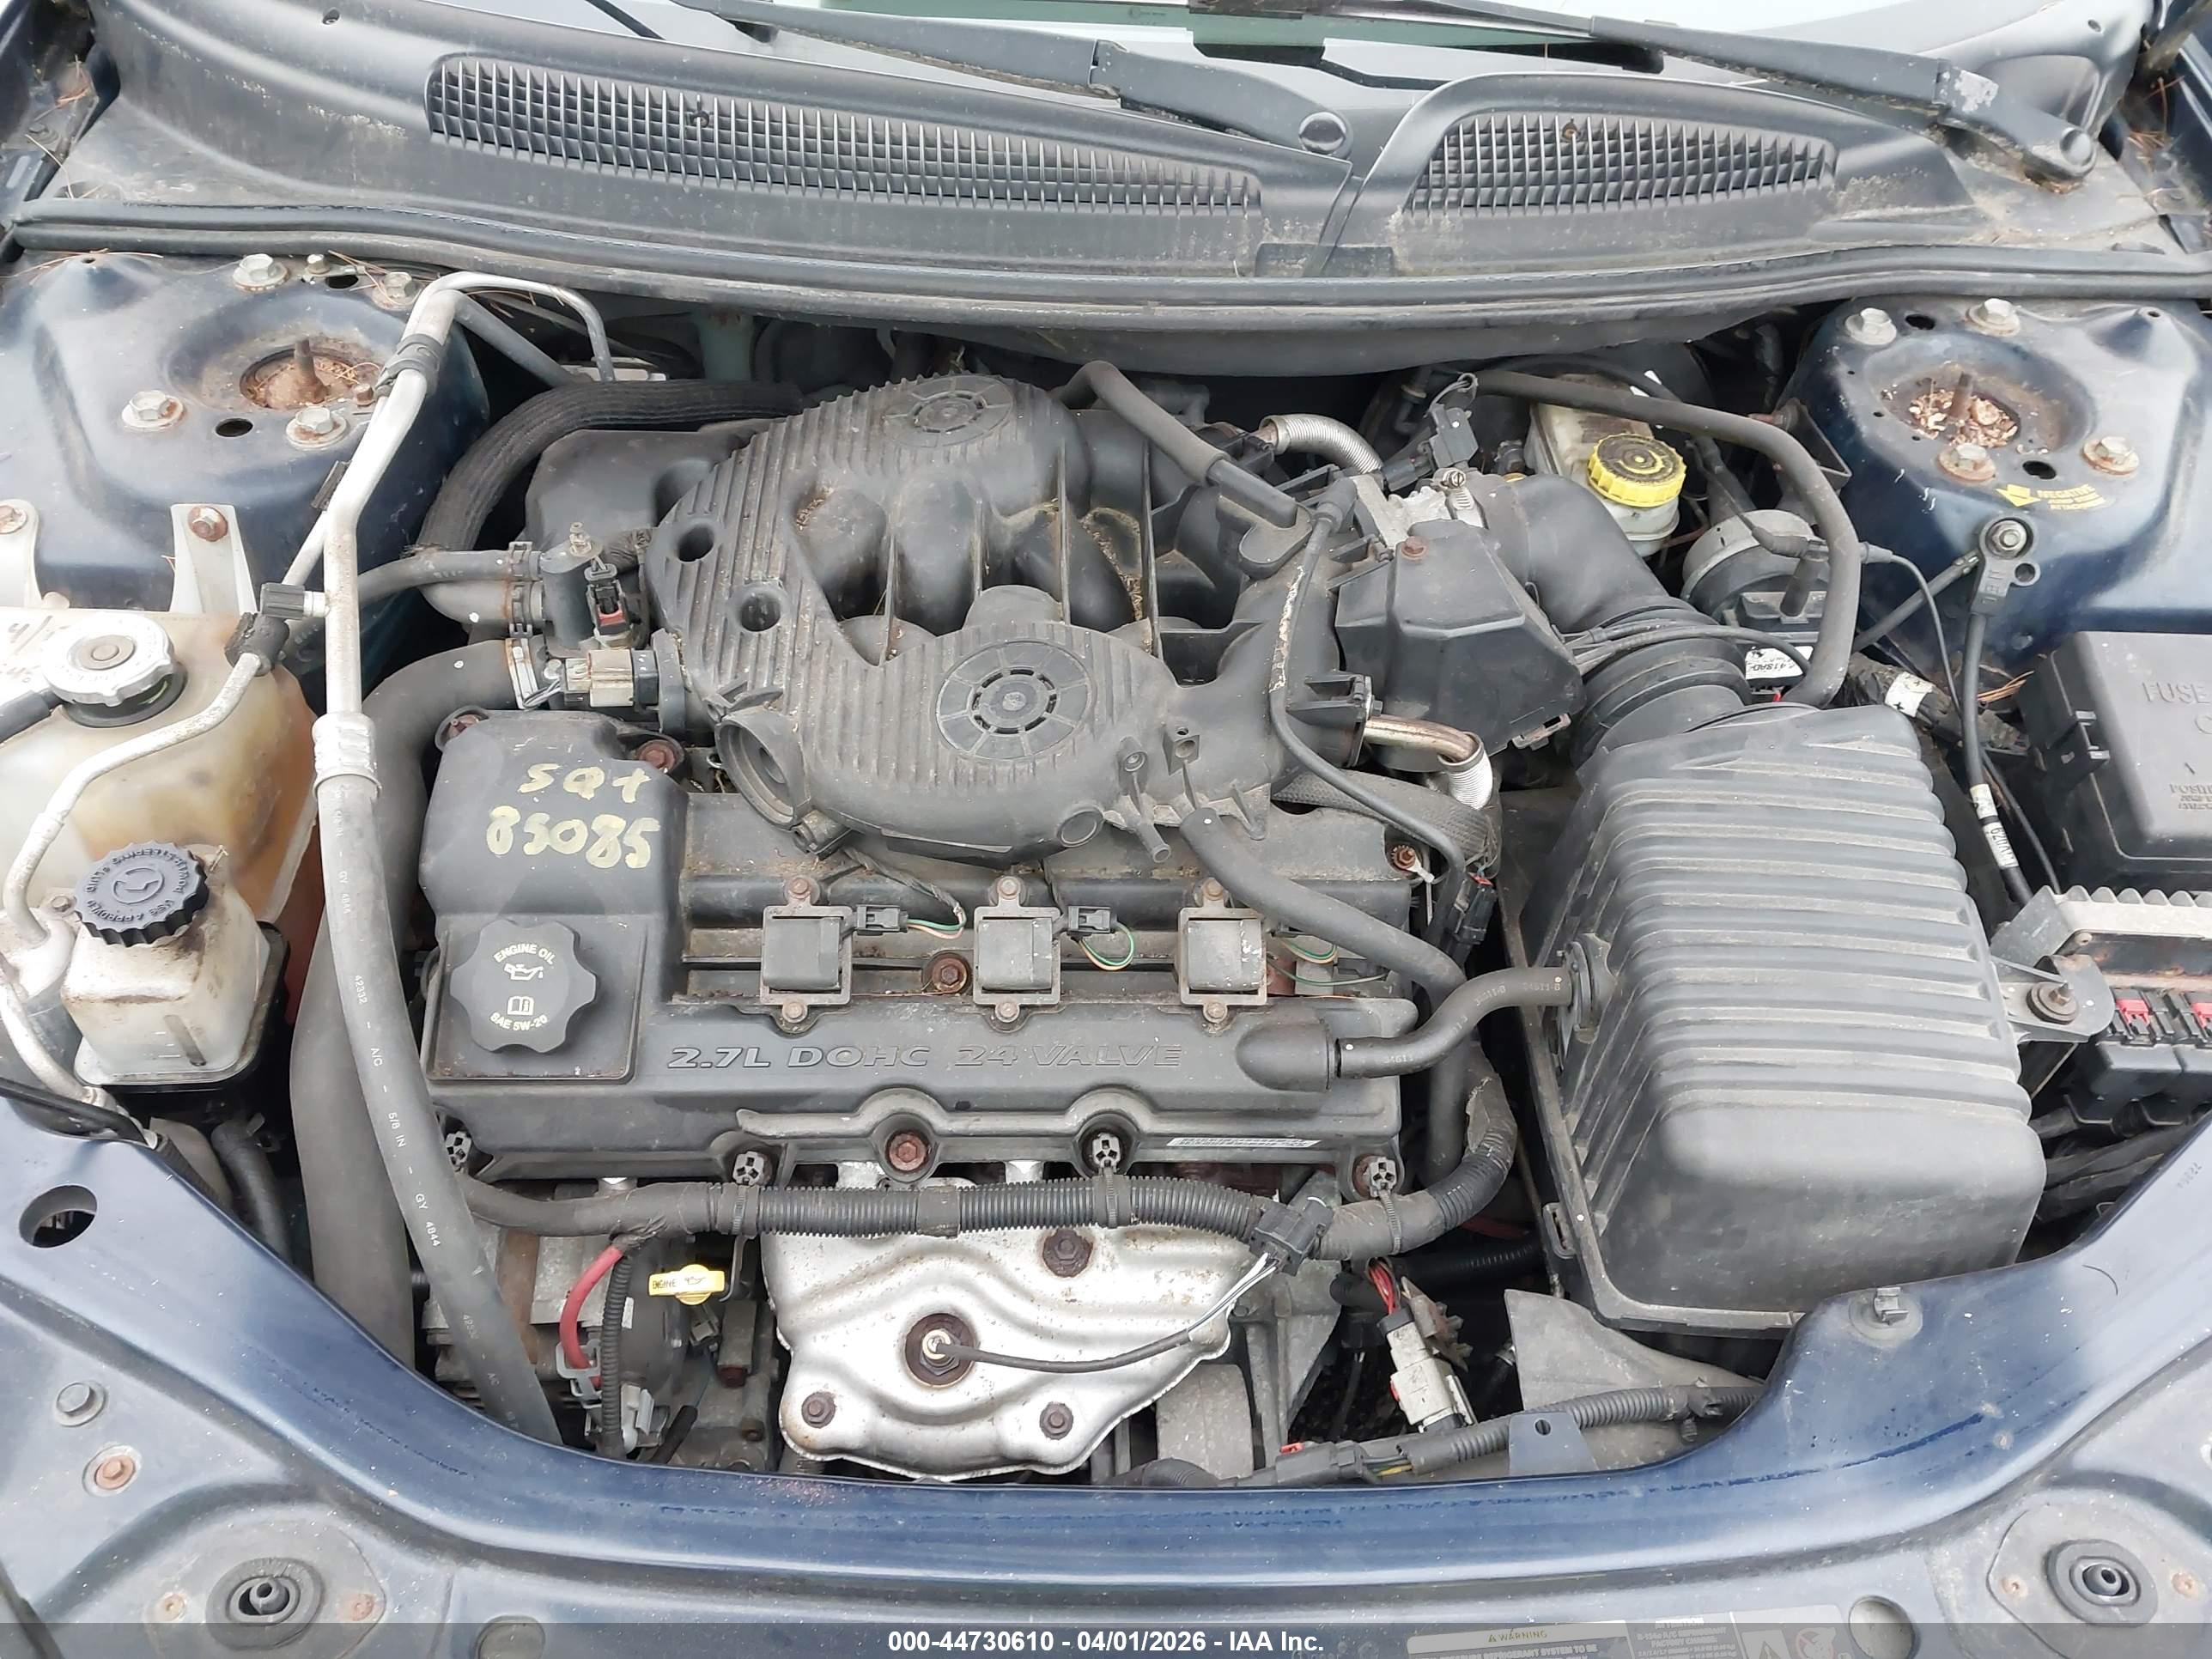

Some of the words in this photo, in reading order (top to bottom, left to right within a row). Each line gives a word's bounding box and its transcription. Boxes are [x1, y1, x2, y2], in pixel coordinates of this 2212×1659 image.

[2142, 683, 2210, 704] FUSE
[493, 943, 538, 963] ENGINE
[538, 947, 556, 965] OIL
[489, 1012, 513, 1030] SAE
[513, 1014, 548, 1031] 5W-20
[666, 1046, 771, 1069] 2.7L
[786, 1045, 931, 1068] DOHC
[953, 1044, 1018, 1067] 24
[1031, 1043, 1182, 1067] VALVE
[394, 1133, 407, 1148] IN
